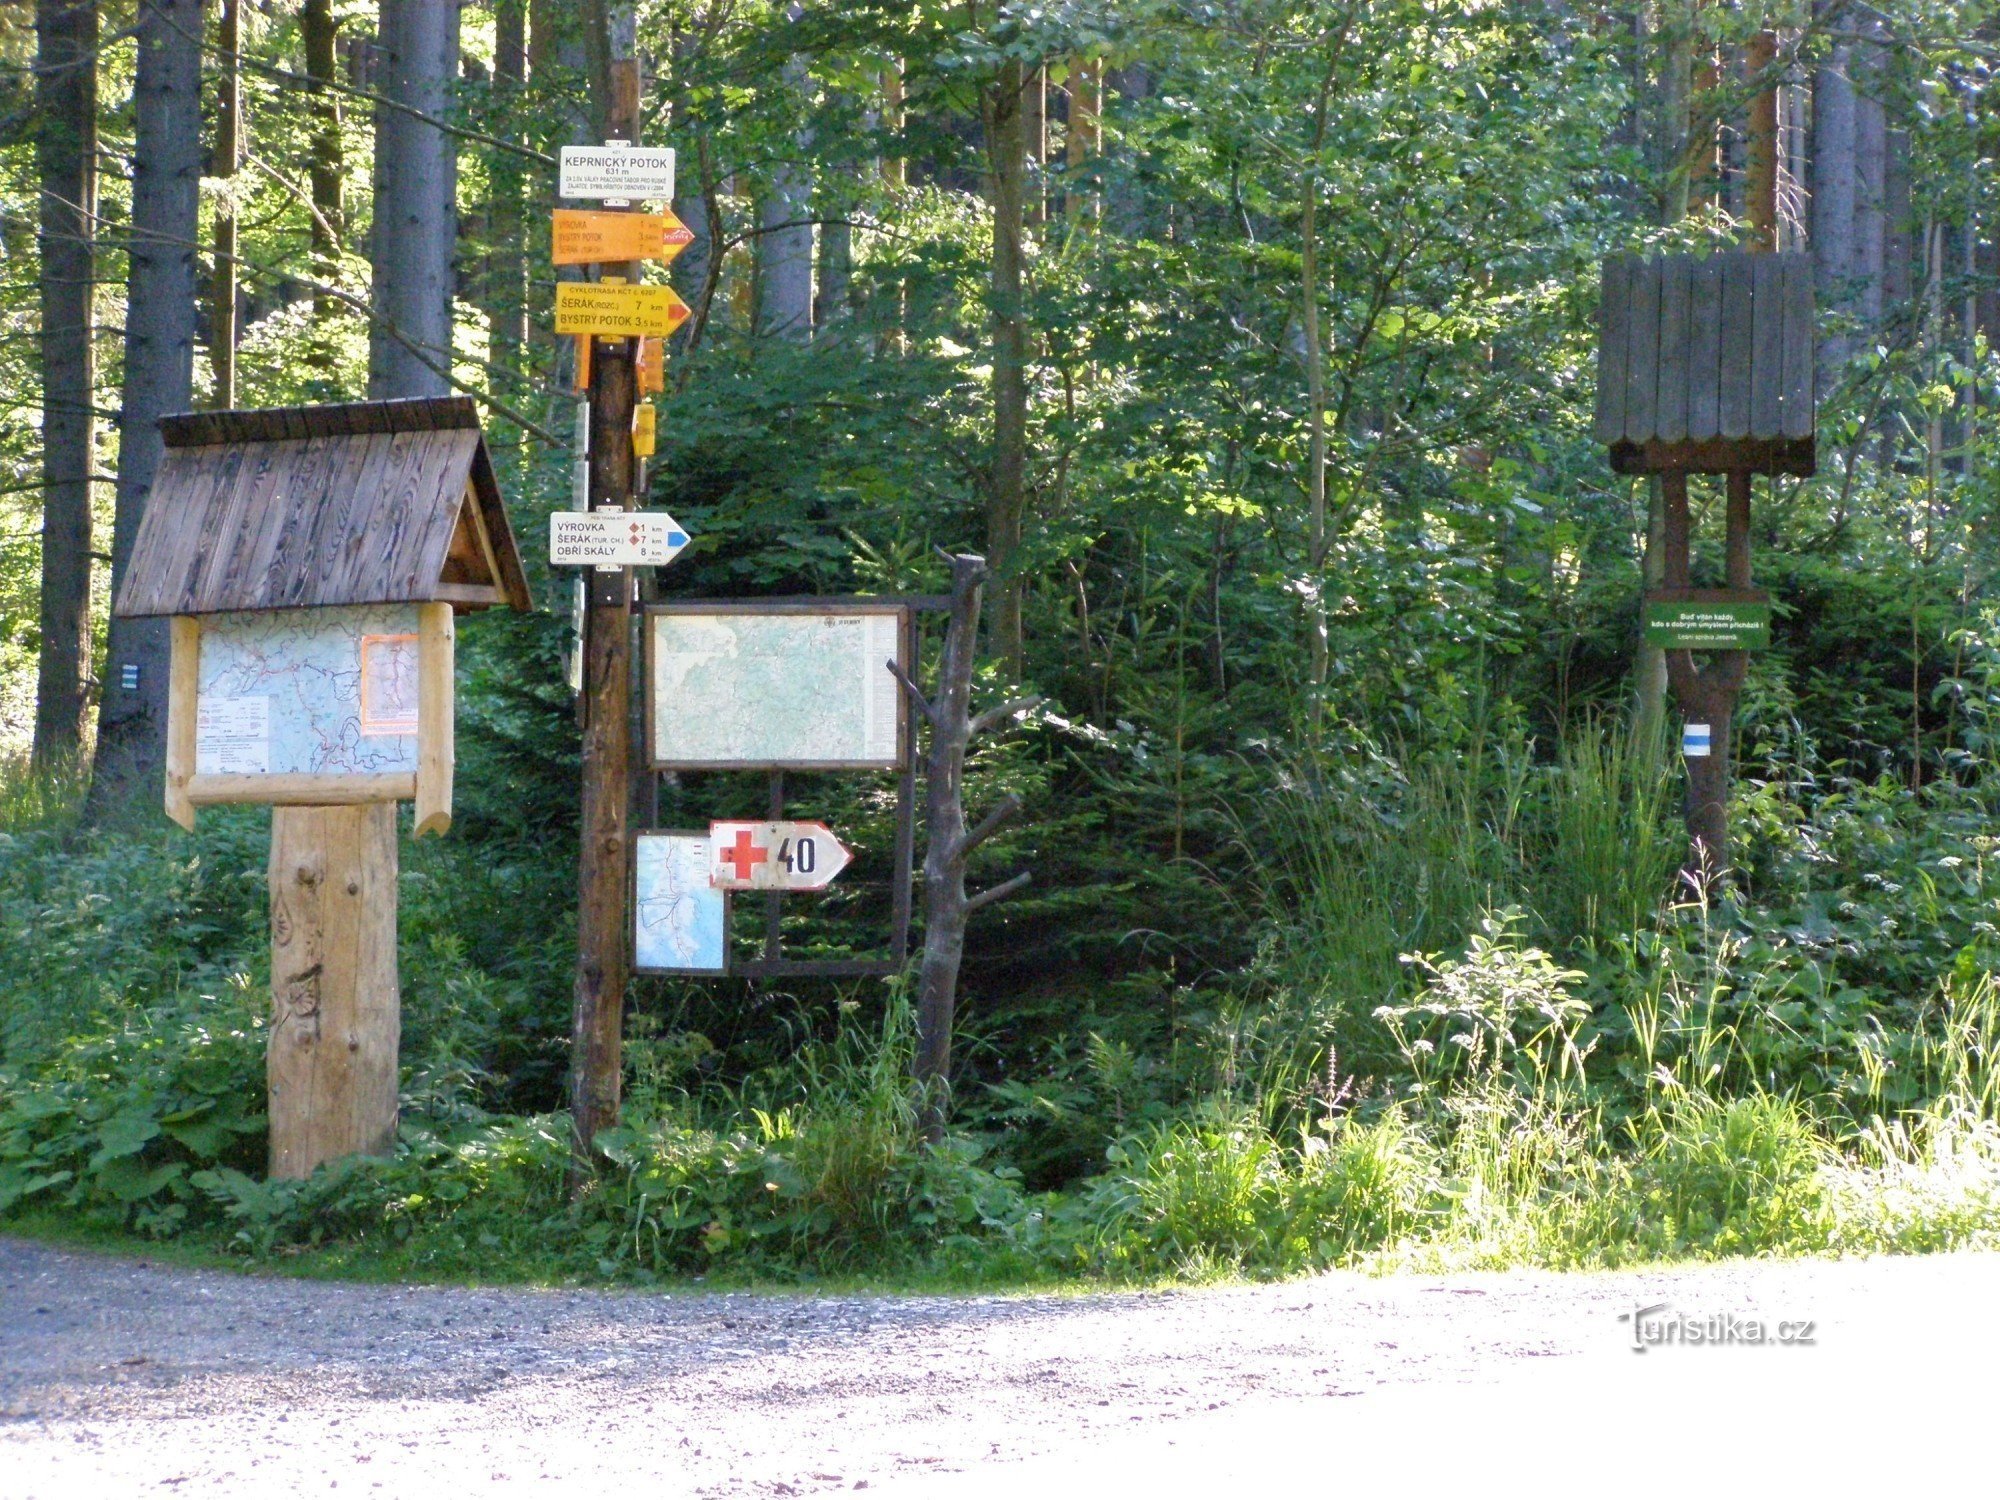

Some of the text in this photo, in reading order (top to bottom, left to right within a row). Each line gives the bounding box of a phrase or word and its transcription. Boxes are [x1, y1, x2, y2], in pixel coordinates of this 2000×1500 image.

[565, 155, 667, 168] KEPRNICKÝ POTOK
[636, 300, 642, 310] 7
[560, 312, 597, 324] BYSTRÝ
[599, 316, 631, 326] POTOK
[557, 521, 605, 531] VÝROVKA
[640, 524, 645, 532] 1
[557, 532, 591, 543] ŠERÁK
[557, 545, 581, 555] OBŘÍ
[584, 545, 616, 556] SKÁLY
[640, 548, 646, 556] 8
[777, 837, 816, 874] 40
